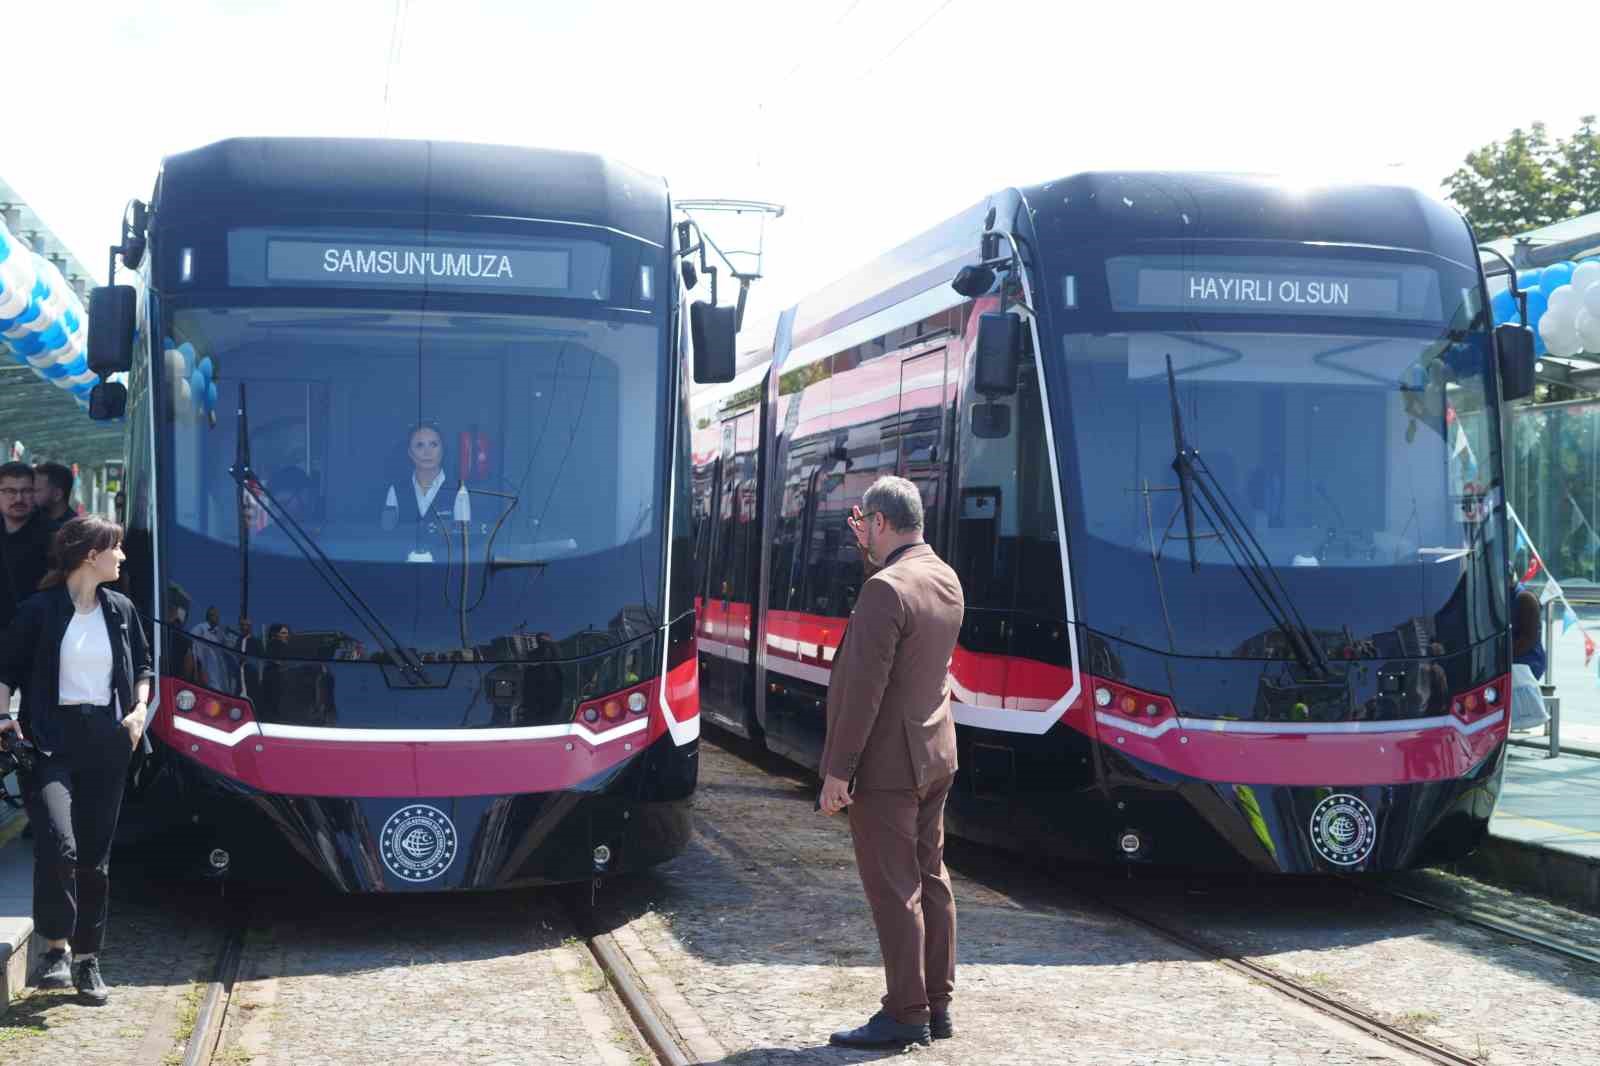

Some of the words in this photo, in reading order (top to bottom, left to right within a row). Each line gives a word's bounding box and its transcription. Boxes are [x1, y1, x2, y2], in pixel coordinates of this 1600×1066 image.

[323, 249, 513, 278] SAMSUN'UMUZA
[1189, 277, 1272, 301] HAYIRLI
[1279, 281, 1349, 304] OLSUN
